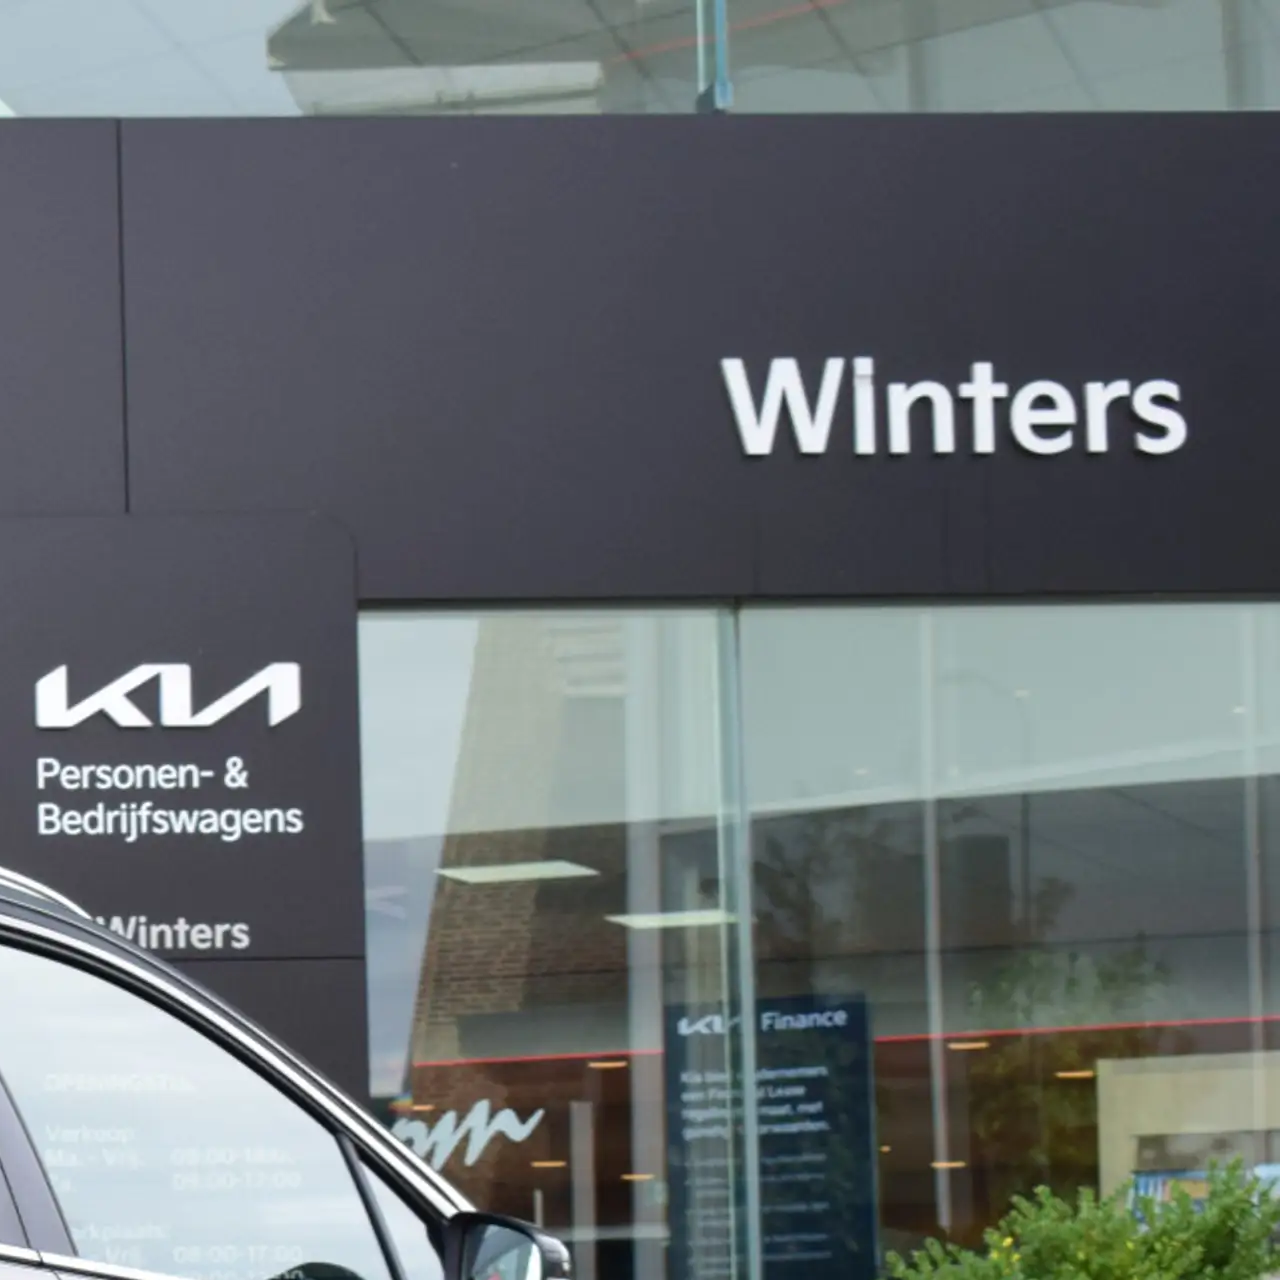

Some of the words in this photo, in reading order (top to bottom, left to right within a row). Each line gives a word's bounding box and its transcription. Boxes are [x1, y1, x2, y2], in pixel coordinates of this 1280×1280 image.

[720, 356, 1188, 457] Winters
[34, 661, 303, 729] KIA
[36, 757, 215, 791] Personen-
[223, 755, 250, 790] &
[37, 800, 304, 843] Bedrijfswagens
[761, 1009, 848, 1032] Finance
